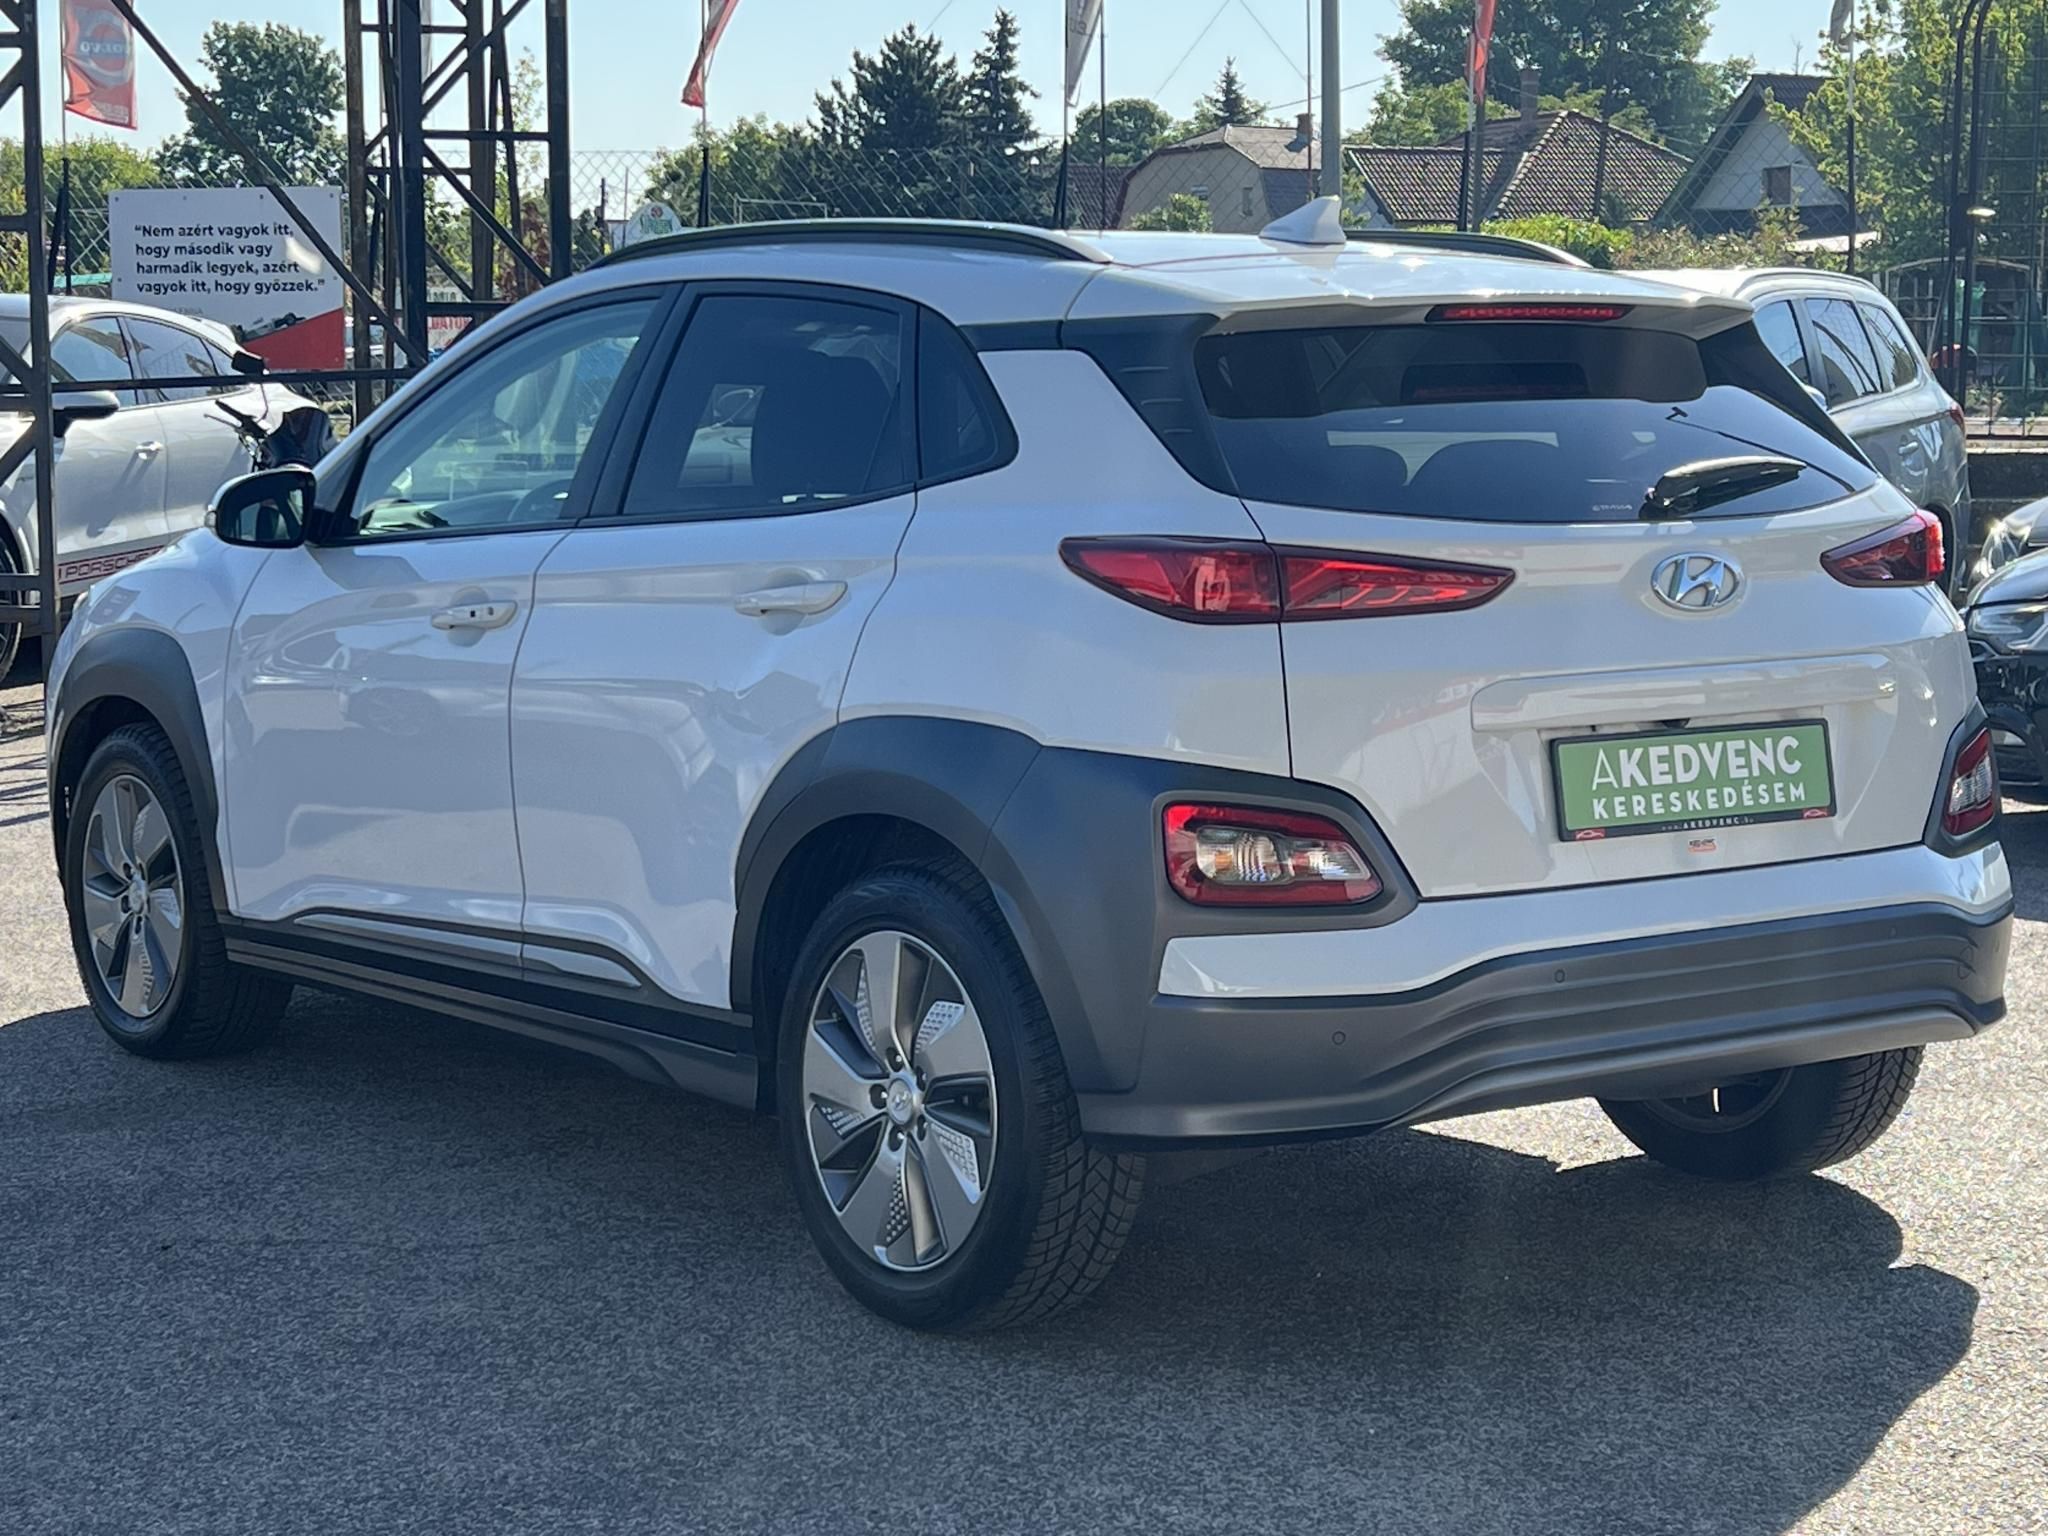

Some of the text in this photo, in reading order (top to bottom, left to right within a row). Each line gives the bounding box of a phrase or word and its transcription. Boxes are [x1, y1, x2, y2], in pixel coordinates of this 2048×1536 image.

[178, 224, 214, 237] azért
[218, 223, 269, 238] vagyok
[273, 222, 294, 236] itt,
[135, 242, 273, 258] hogy második vagy
[136, 261, 300, 276] harmadik legyek, azért
[137, 280, 187, 295] vagyok
[191, 280, 211, 294] itt,
[215, 280, 250, 294] hogy
[1593, 780, 1806, 820] KERESKEDÉSEM
